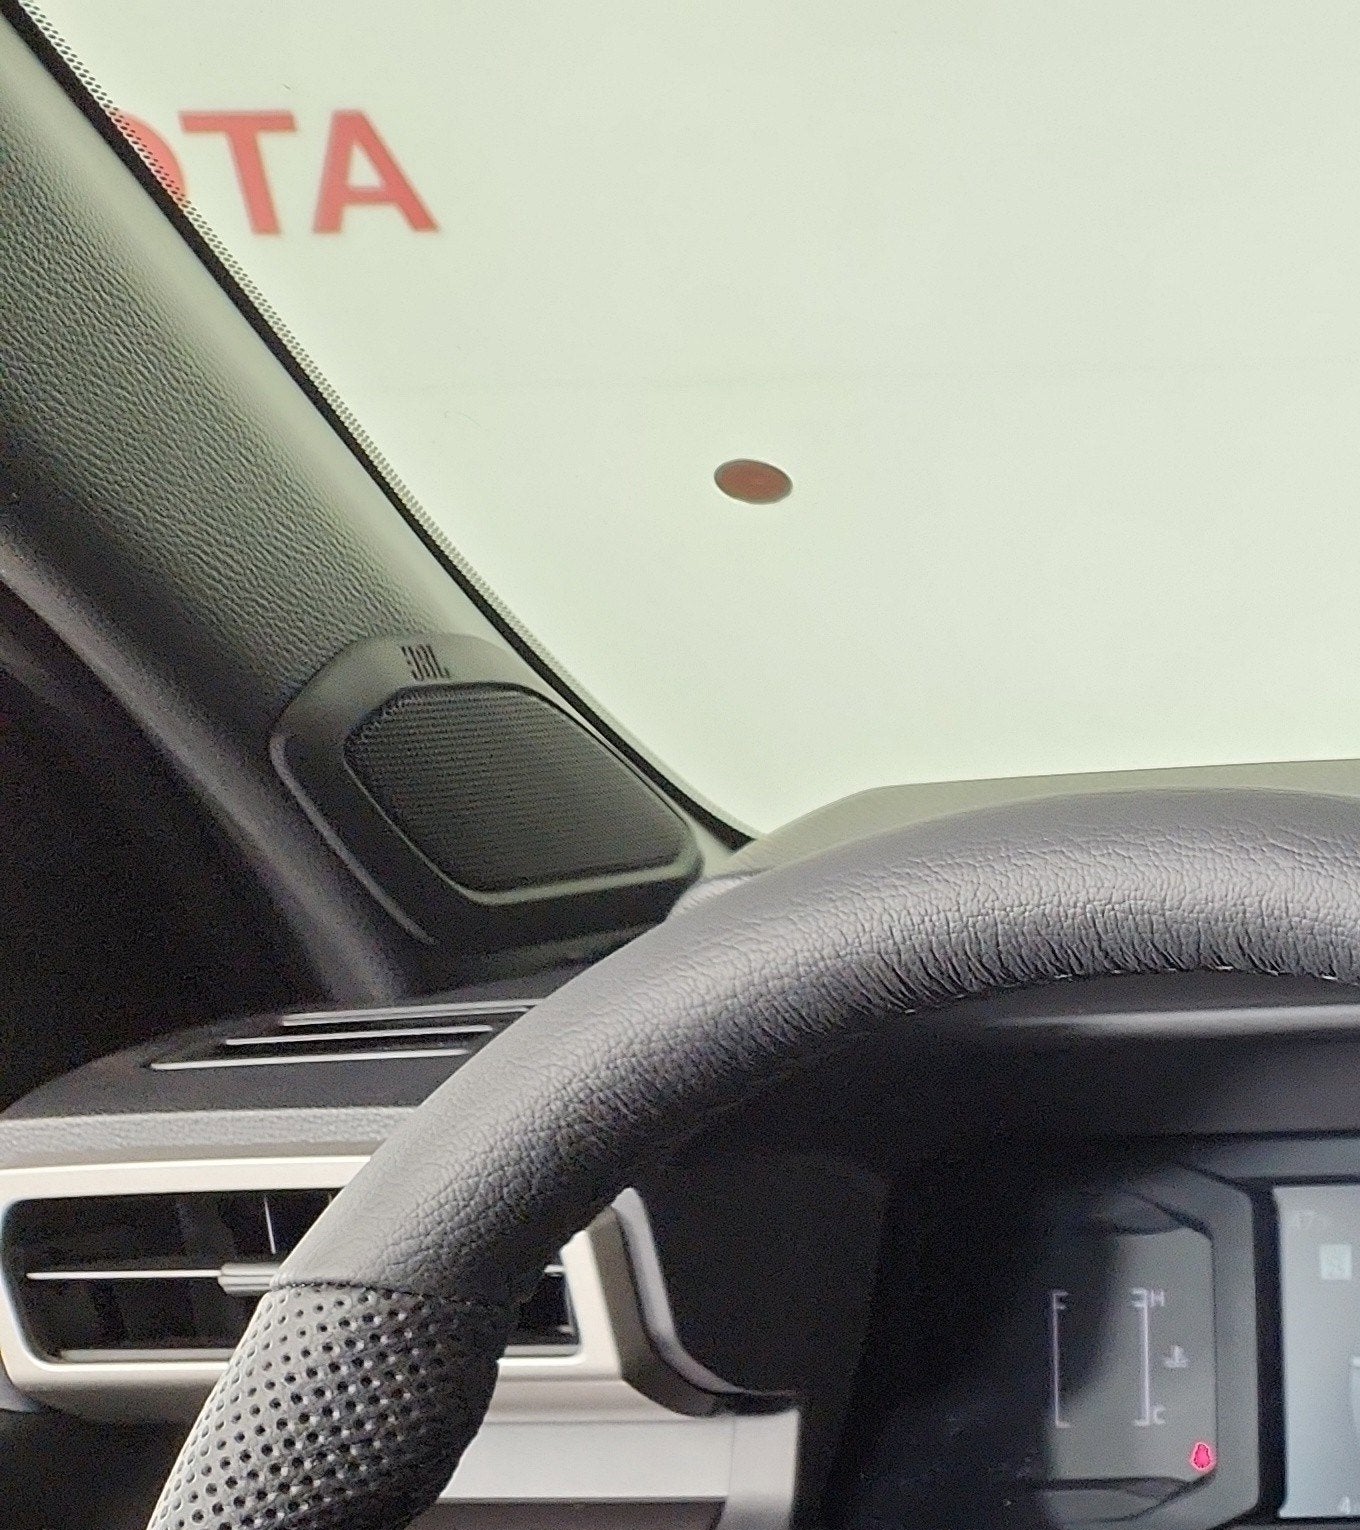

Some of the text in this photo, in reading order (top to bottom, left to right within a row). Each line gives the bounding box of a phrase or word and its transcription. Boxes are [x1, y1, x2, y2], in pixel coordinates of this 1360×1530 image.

[110, 109, 440, 235] TA
[401, 645, 450, 681] JBL
[1148, 1290, 1165, 1307] H
[1151, 1406, 1166, 1425] C
